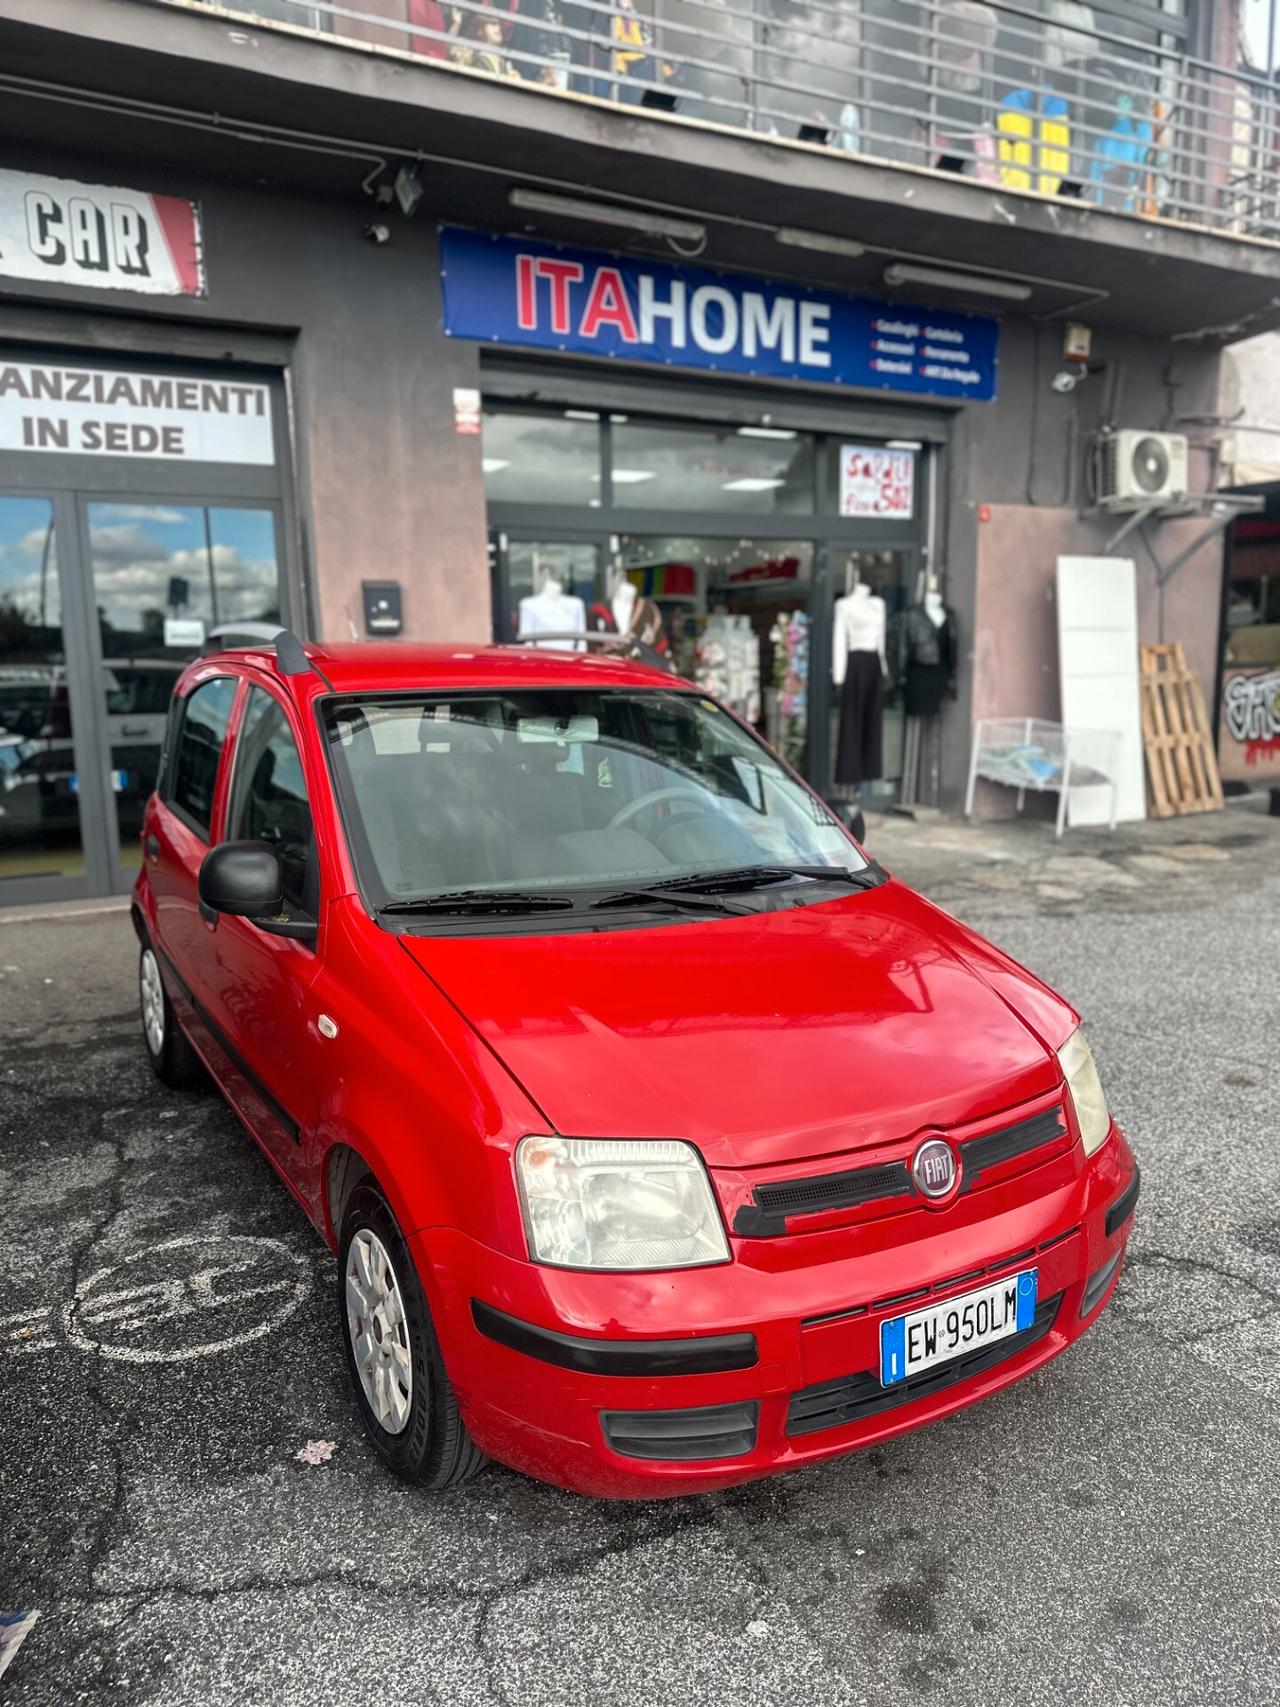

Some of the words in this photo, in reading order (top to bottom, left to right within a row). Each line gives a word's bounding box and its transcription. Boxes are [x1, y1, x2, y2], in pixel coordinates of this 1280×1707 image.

[24, 190, 152, 278] CAR
[516, 254, 831, 368] ITAHOME
[22, 416, 69, 448] IN
[81, 420, 185, 454] SEDE
[924, 1154, 949, 1185] FIAT
[907, 1317, 938, 1364] EW
[946, 1287, 1017, 1348] 950LM
